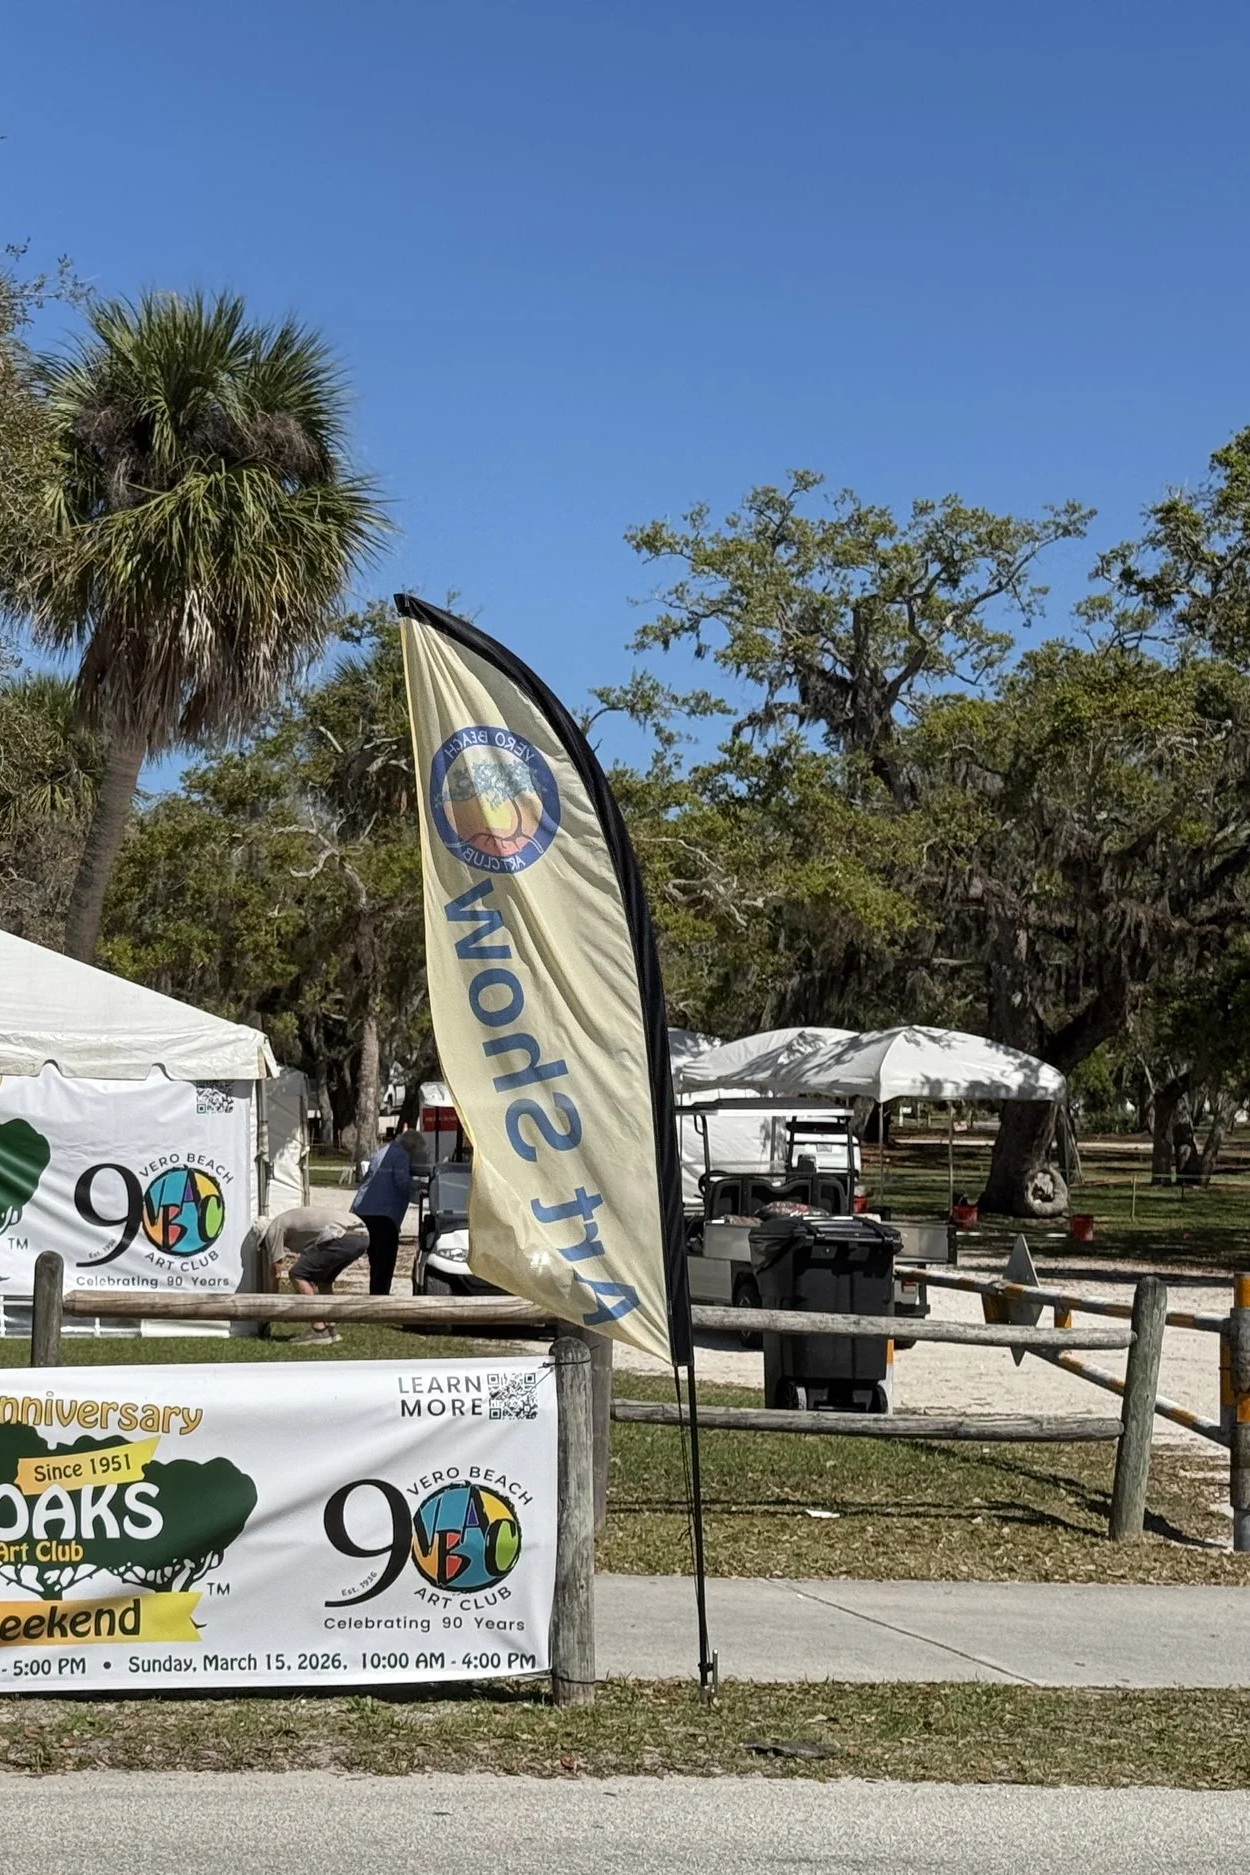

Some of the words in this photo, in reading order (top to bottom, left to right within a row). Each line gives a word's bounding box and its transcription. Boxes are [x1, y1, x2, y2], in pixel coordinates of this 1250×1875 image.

[139, 1153, 180, 1178] VERO
[187, 1153, 234, 1184] BEACH
[8, 1238, 28, 1249] TM
[145, 1251, 174, 1271] ART
[180, 1250, 219, 1272] CLUB
[76, 1276, 159, 1289] Celebrating
[167, 1276, 183, 1287] 90
[191, 1276, 229, 1287] Years
[398, 1376, 482, 1394] LEARN
[401, 1398, 483, 1417] MORE
[34, 1460, 82, 1483] Since
[90, 1453, 131, 1474] 1951
[406, 1467, 460, 1496] VERO
[469, 1466, 533, 1506] BEACH
[35, 1540, 84, 1562] Club
[206, 1582, 231, 1596] TM
[341, 1587, 359, 1596] Est.
[359, 1571, 377, 1588] 1936
[414, 1586, 452, 1610] ART
[460, 1586, 512, 1611] CLUB
[324, 1616, 431, 1633] Celebrating
[442, 1617, 463, 1629] 90
[474, 1617, 525, 1631] Years
[13, 1659, 52, 1676] 5:00
[58, 1658, 86, 1675] PM
[129, 1654, 197, 1674] Sunday,
[203, 1653, 257, 1671] March
[266, 1654, 292, 1672] 15,
[297, 1653, 348, 1671] 2026,
[361, 1653, 409, 1669] 10:00
[415, 1652, 445, 1669] AM
[461, 1652, 501, 1669] 4:00
[508, 1652, 536, 1669] PM
